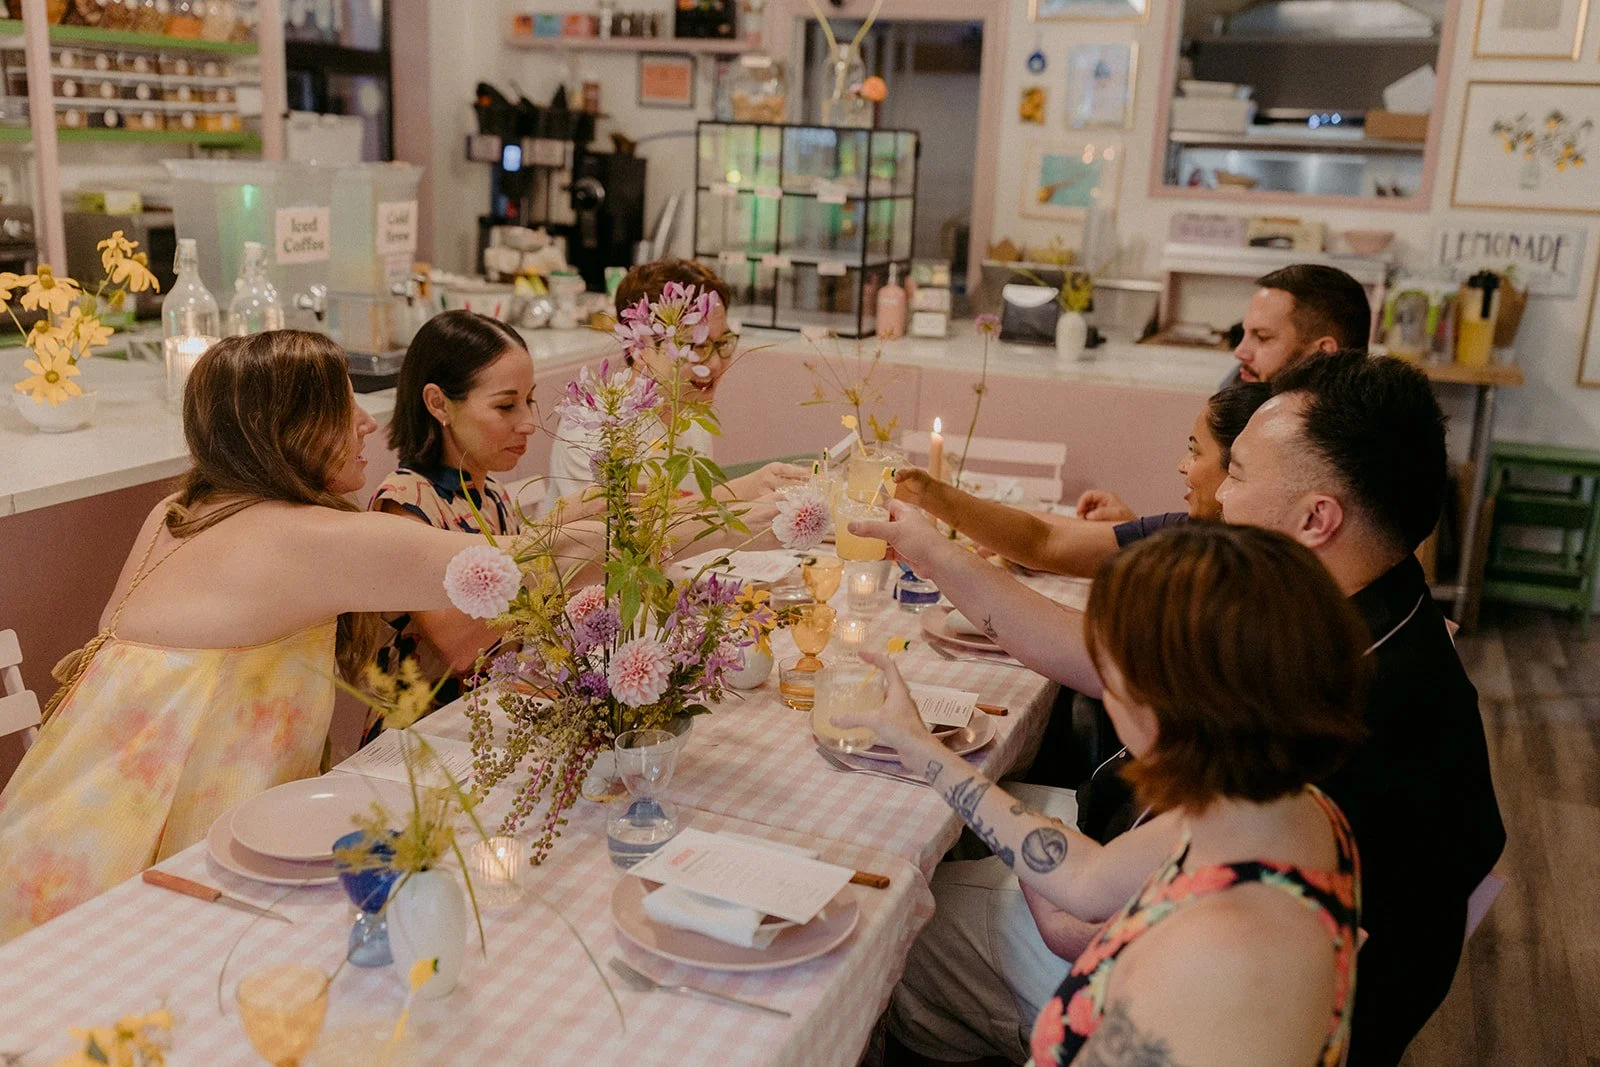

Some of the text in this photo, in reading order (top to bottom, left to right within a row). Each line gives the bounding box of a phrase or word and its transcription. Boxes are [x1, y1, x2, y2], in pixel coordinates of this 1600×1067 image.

[291, 217, 318, 232] Iced
[283, 236, 324, 253] Coffee
[1439, 230, 1571, 271] LEMONADE
